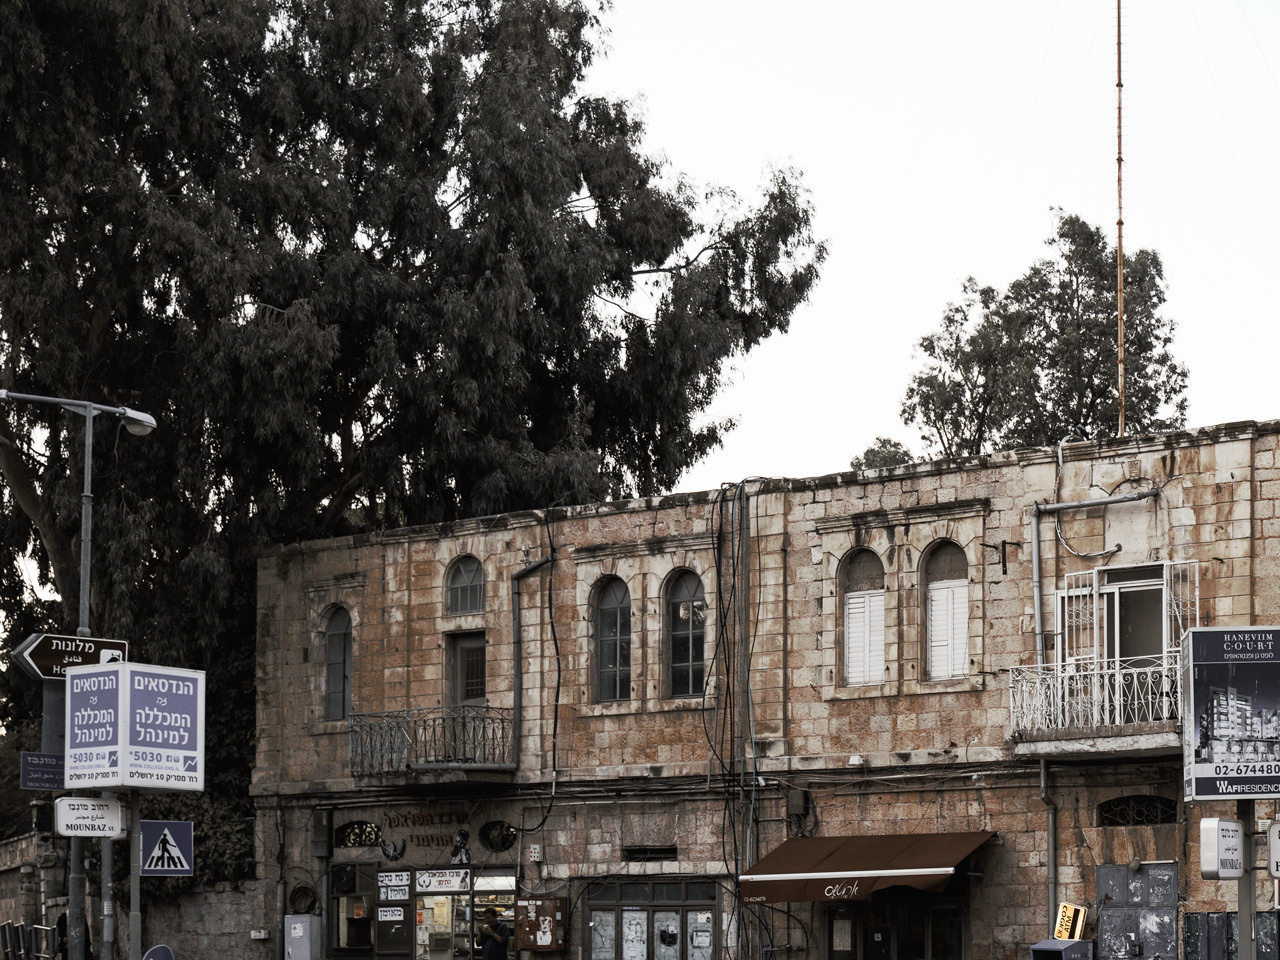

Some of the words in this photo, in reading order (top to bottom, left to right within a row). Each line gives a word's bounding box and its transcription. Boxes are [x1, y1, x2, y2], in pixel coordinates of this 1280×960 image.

[1223, 633, 1273, 641] HANEVIIM
[51, 639, 95, 653] מלונות
[63, 655, 82, 664] فنادق
[73, 675, 116, 693] הנדסאים
[134, 676, 194, 696] הנדסאים
[89, 695, 98, 705] זה
[156, 697, 168, 707] זה
[74, 707, 114, 726] המכללה
[136, 706, 191, 728] המכללה
[75, 724, 113, 743] למינהל
[136, 723, 189, 745] למינהל
[129, 771, 154, 780] ירושלים
[68, 803, 89, 811] מונבז
[91, 803, 110, 811] רחוב
[91, 813, 105, 821] شارع
[65, 823, 107, 832] MOUNBAZ
[1064, 915, 1072, 933] ATM
